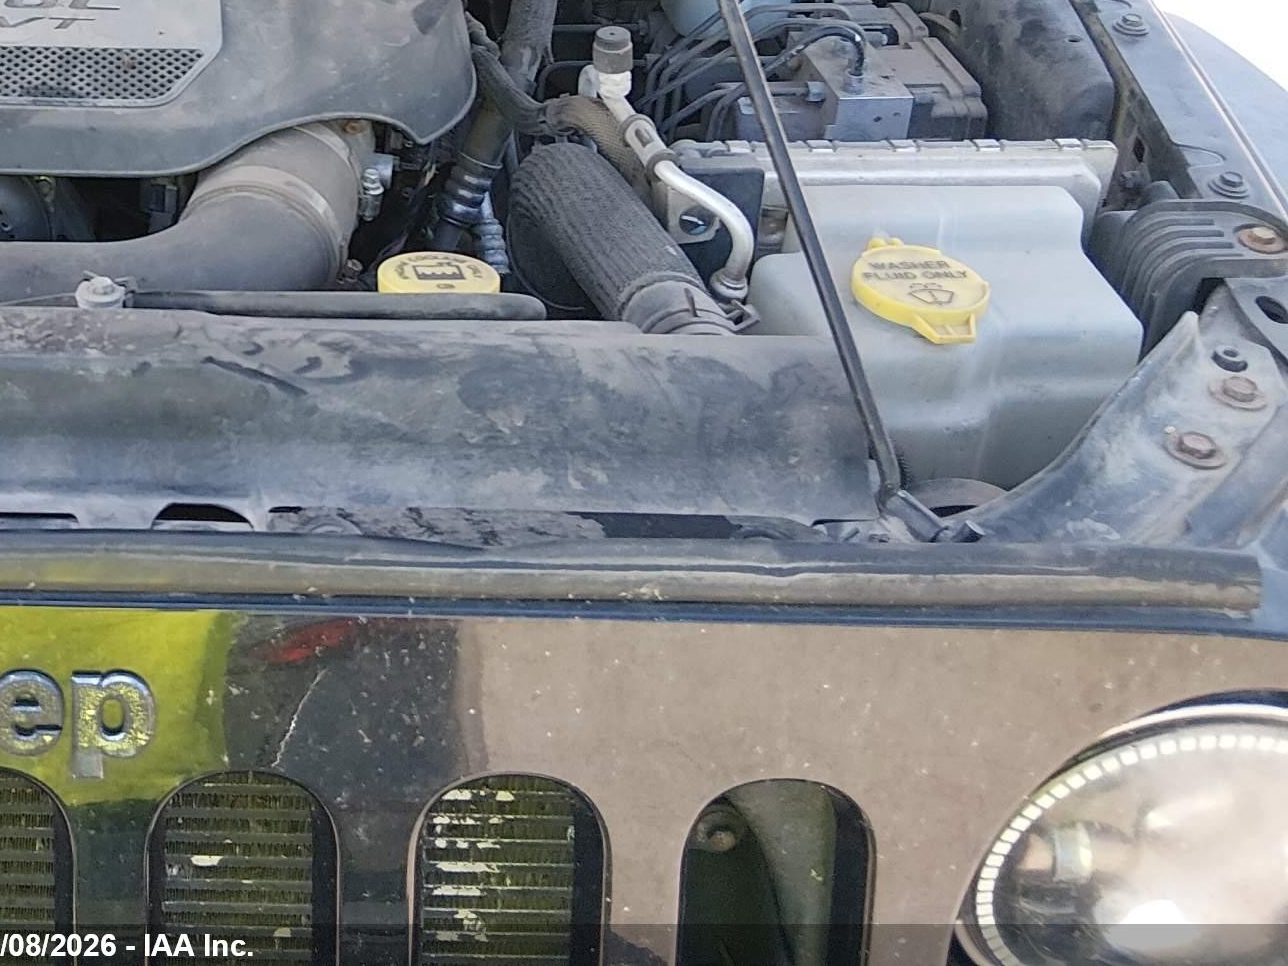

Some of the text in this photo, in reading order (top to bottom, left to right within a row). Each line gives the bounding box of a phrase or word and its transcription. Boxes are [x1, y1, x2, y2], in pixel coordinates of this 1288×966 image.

[868, 260, 951, 270] WASHER
[862, 270, 968, 281] FLUID ONLY
